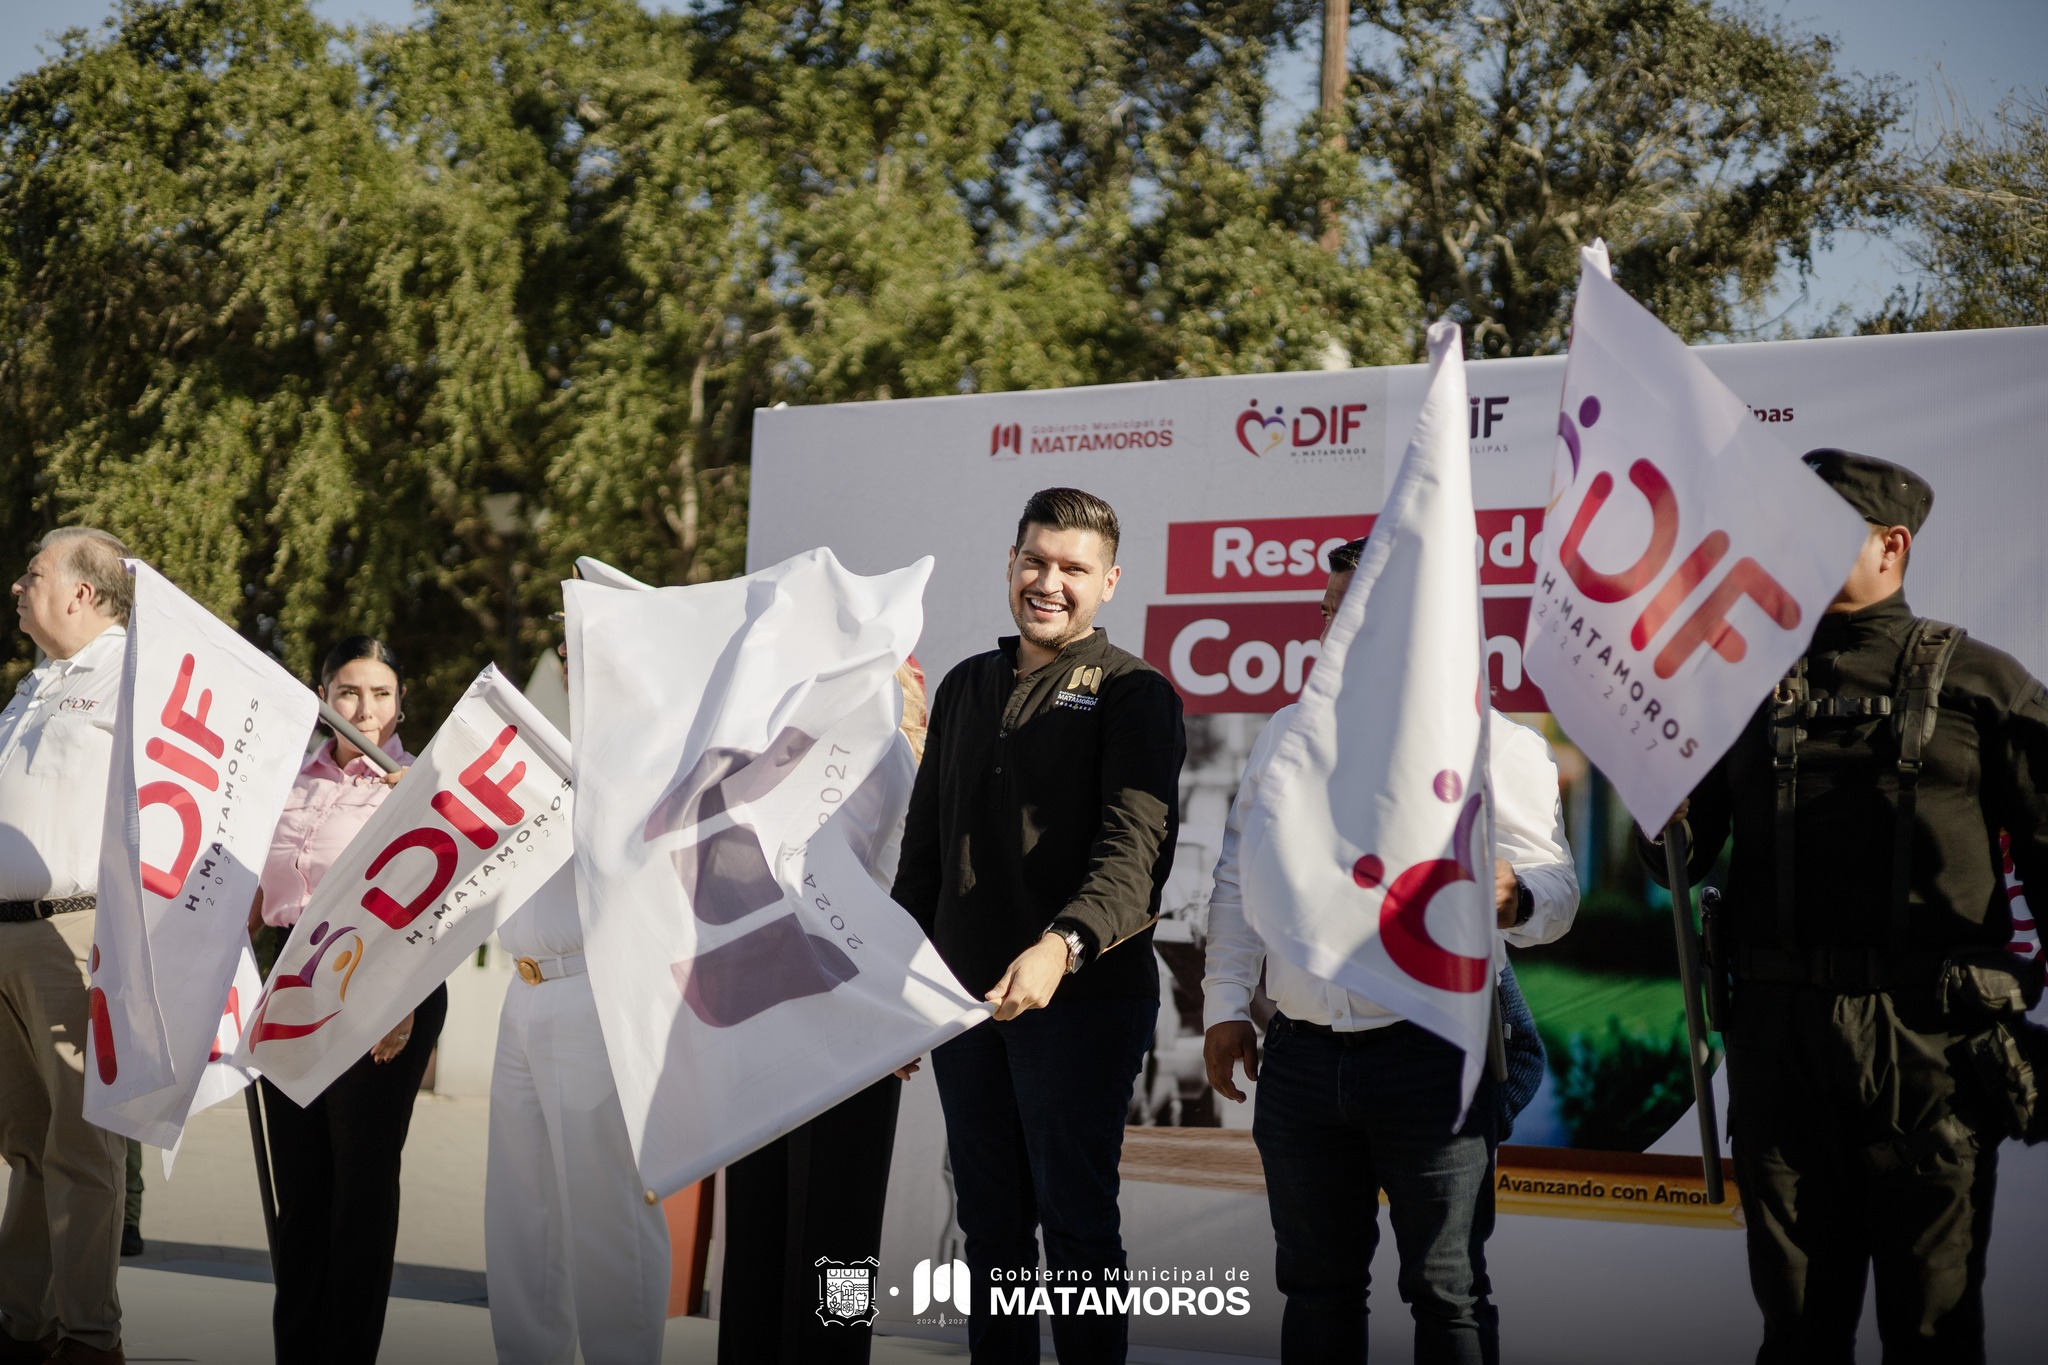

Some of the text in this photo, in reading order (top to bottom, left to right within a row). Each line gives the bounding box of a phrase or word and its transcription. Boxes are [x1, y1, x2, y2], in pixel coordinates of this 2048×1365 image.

[1030, 429, 1173, 454] MATAMOROS
[1292, 404, 1367, 447] DIF
[1559, 457, 1803, 680] DIF
[138, 652, 225, 900] DIF
[360, 724, 526, 931] DIF
[1498, 1174, 1605, 1198] Avanzando
[1612, 1185, 1648, 1201] con
